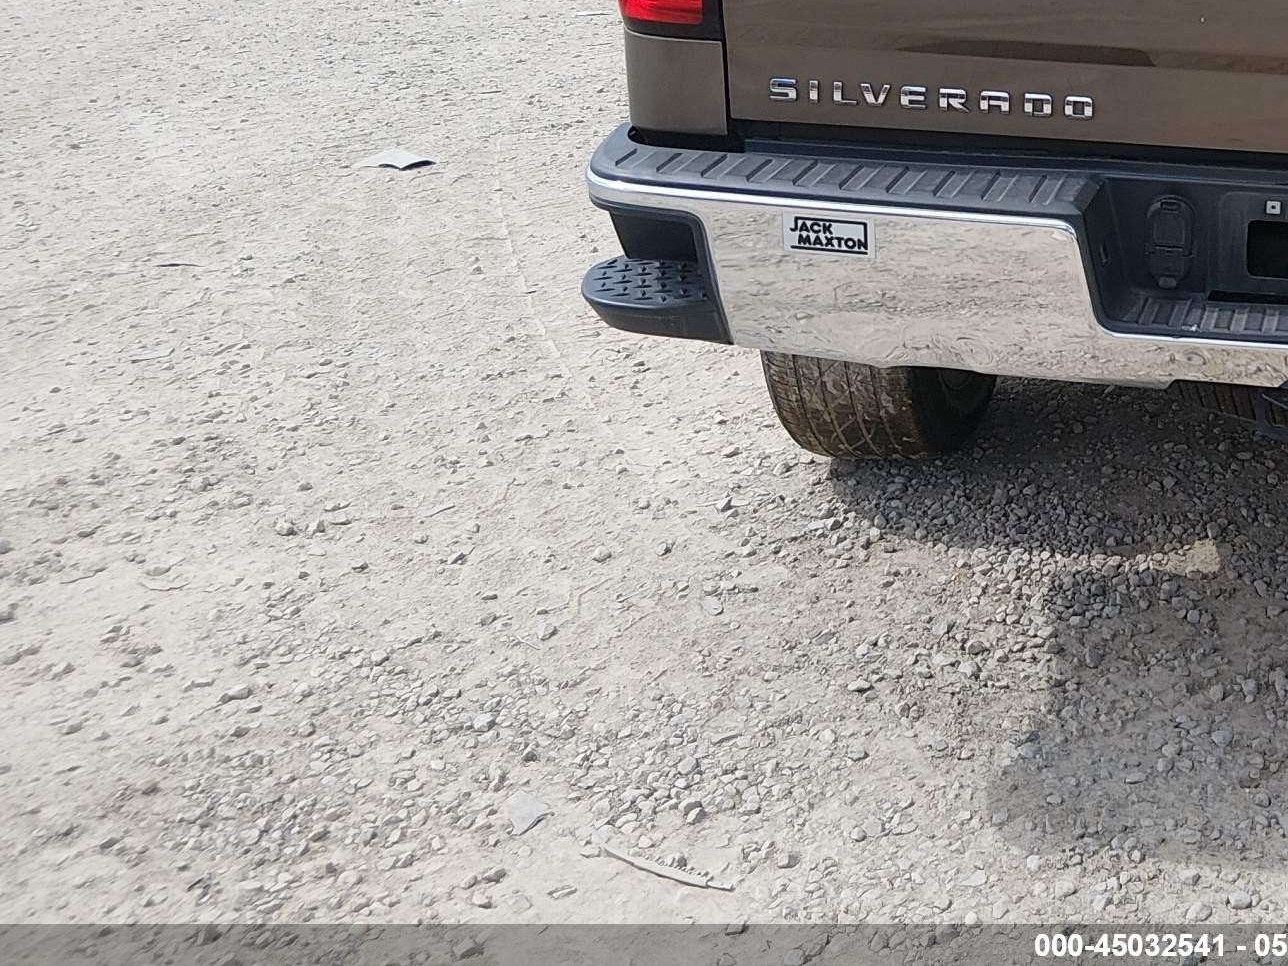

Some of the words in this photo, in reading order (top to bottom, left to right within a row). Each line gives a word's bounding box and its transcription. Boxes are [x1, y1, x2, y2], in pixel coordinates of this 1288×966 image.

[768, 77, 1094, 119] SILVERADO
[789, 216, 833, 234] JACK
[797, 233, 868, 250] MAXTON
